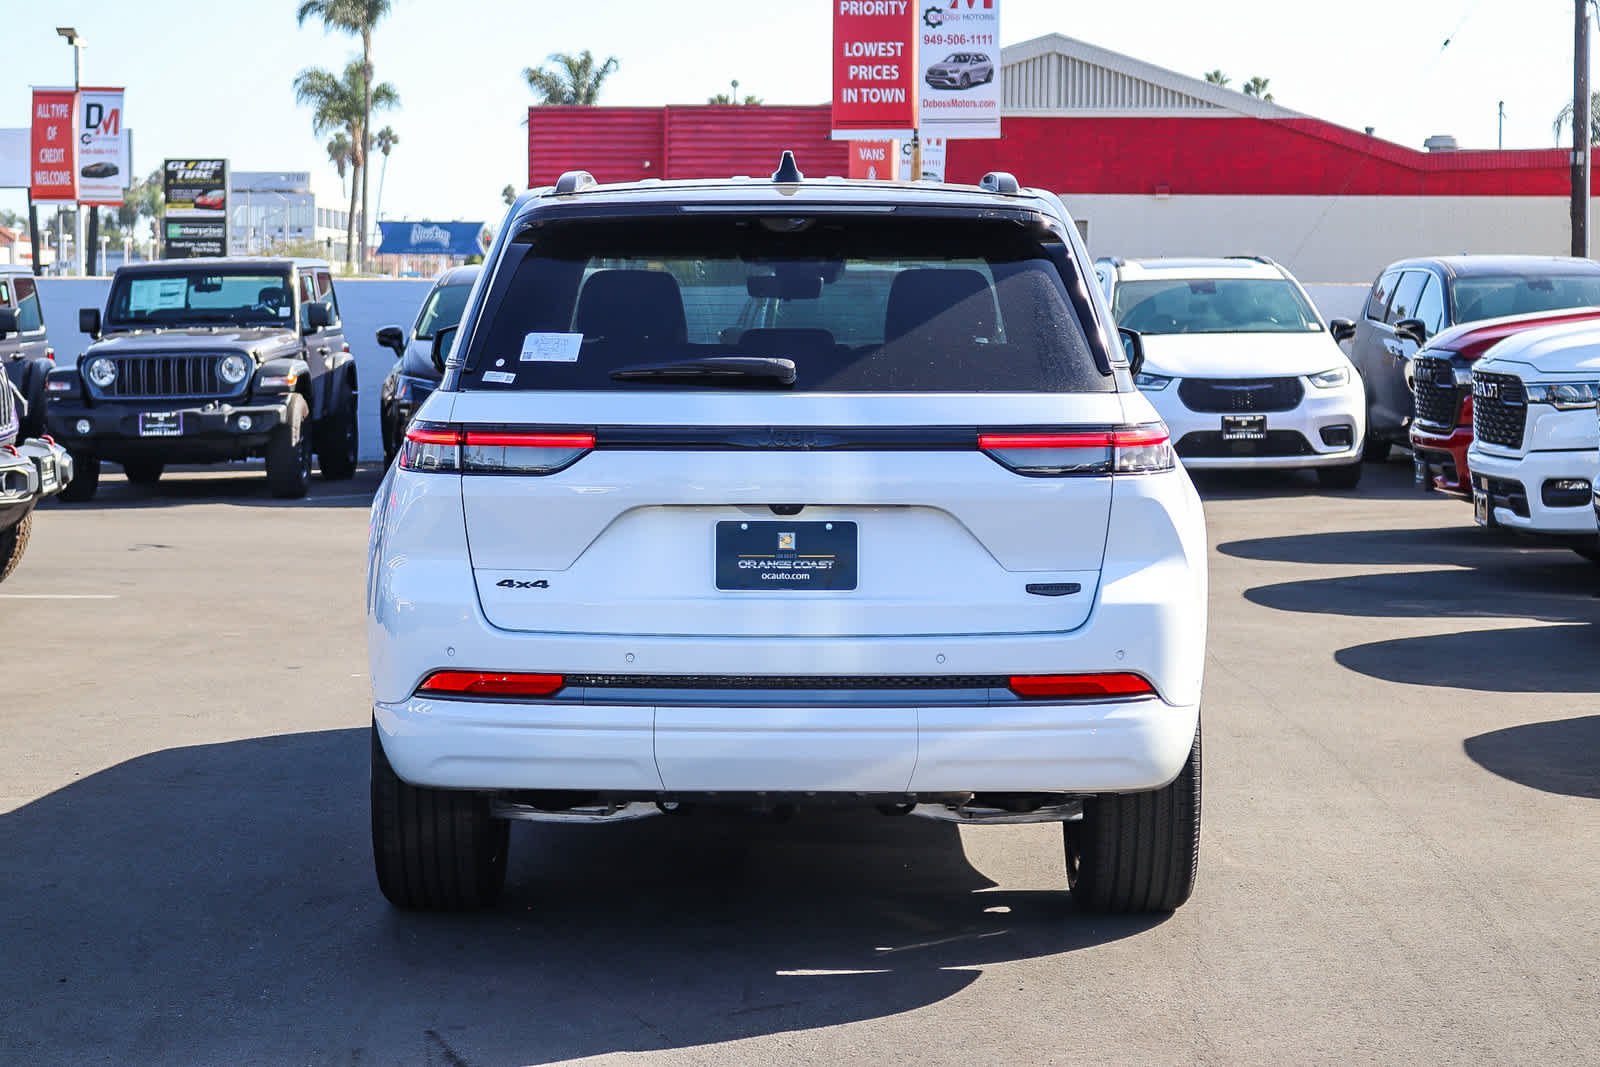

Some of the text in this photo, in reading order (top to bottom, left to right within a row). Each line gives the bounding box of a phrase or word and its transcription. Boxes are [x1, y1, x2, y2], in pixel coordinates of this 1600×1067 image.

[840, 1, 907, 16] PRIORITY
[924, 34, 993, 45] 949-506-1111
[844, 42, 904, 57] LOWEST
[849, 65, 899, 80] PRICES
[842, 88, 905, 103] IN TOWN
[46, 126, 58, 140] OF
[39, 147, 65, 163] CREDIT
[858, 147, 885, 160] VANS
[34, 170, 71, 185] WELCOME
[738, 560, 835, 569] ORANGE COAST
[761, 572, 810, 580] ocauto.com
[496, 579, 550, 589] 4x4
